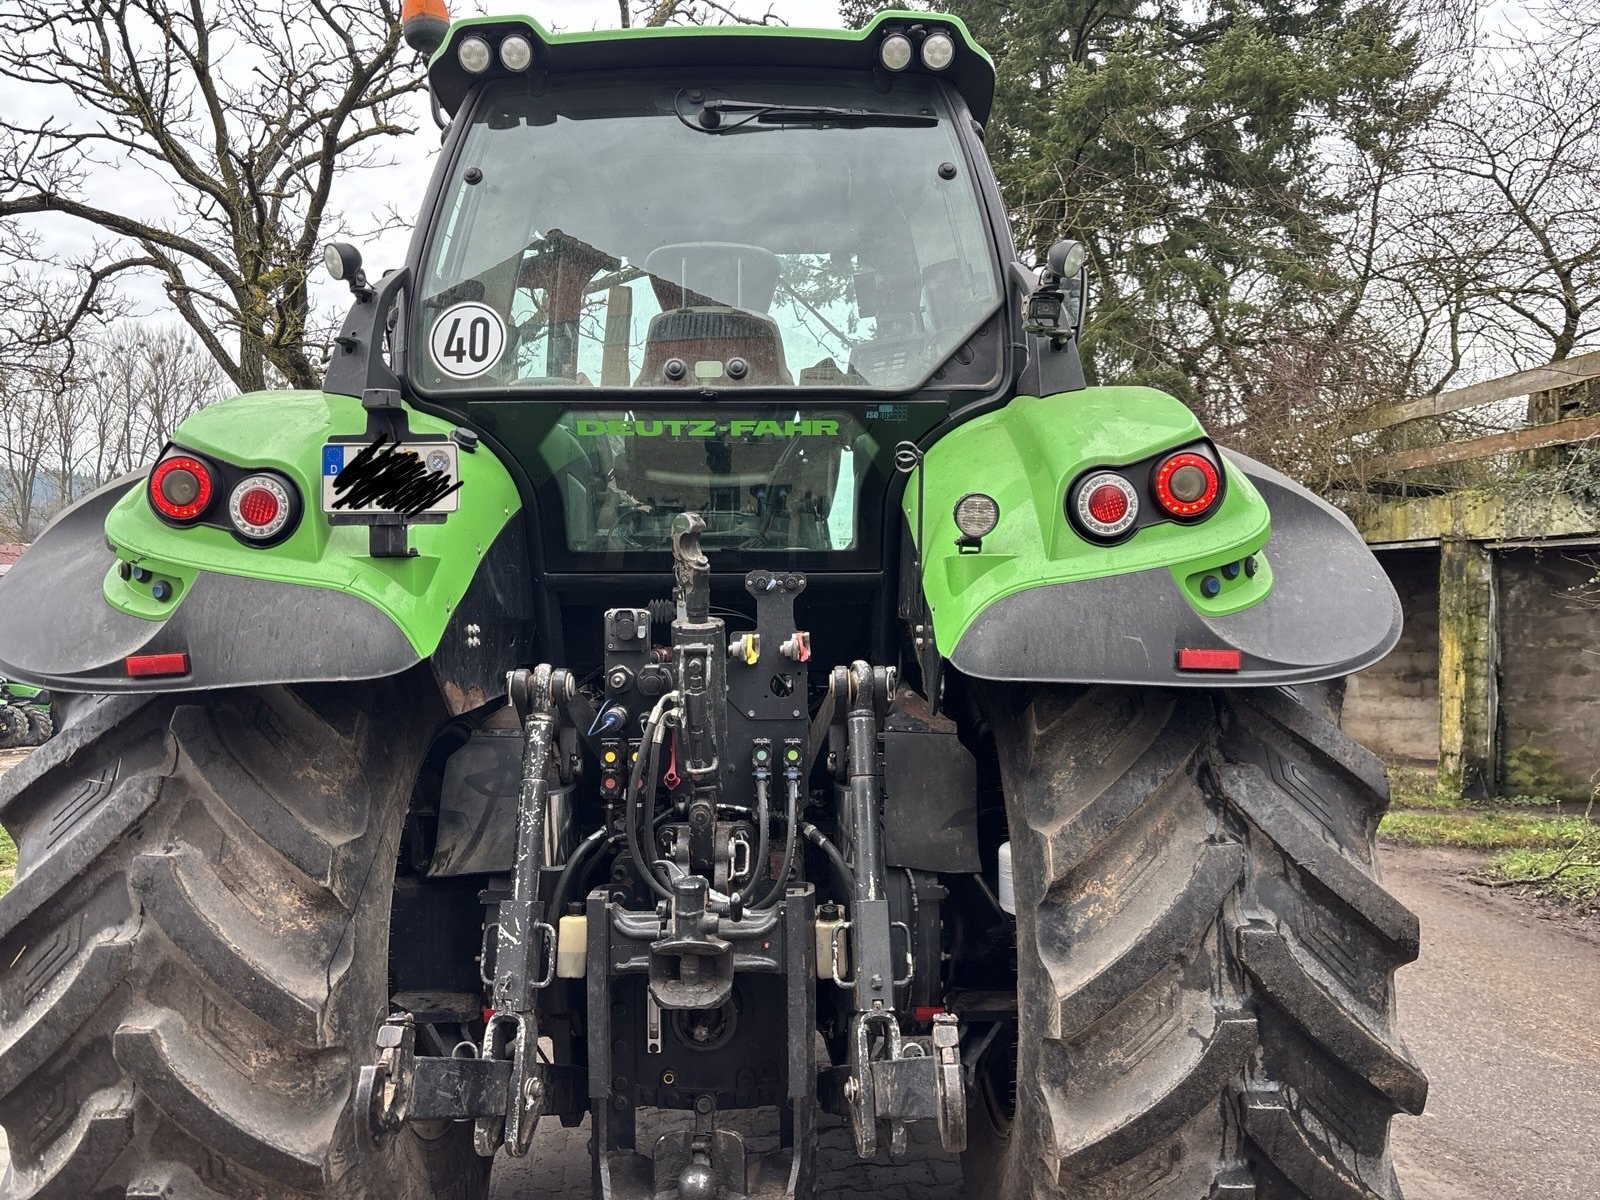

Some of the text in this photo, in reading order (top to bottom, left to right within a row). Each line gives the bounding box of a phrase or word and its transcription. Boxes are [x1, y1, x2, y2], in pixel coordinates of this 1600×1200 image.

[443, 316, 490, 363] 40
[576, 420, 840, 437] DEUTZ-FAHR
[330, 464, 338, 474] D
